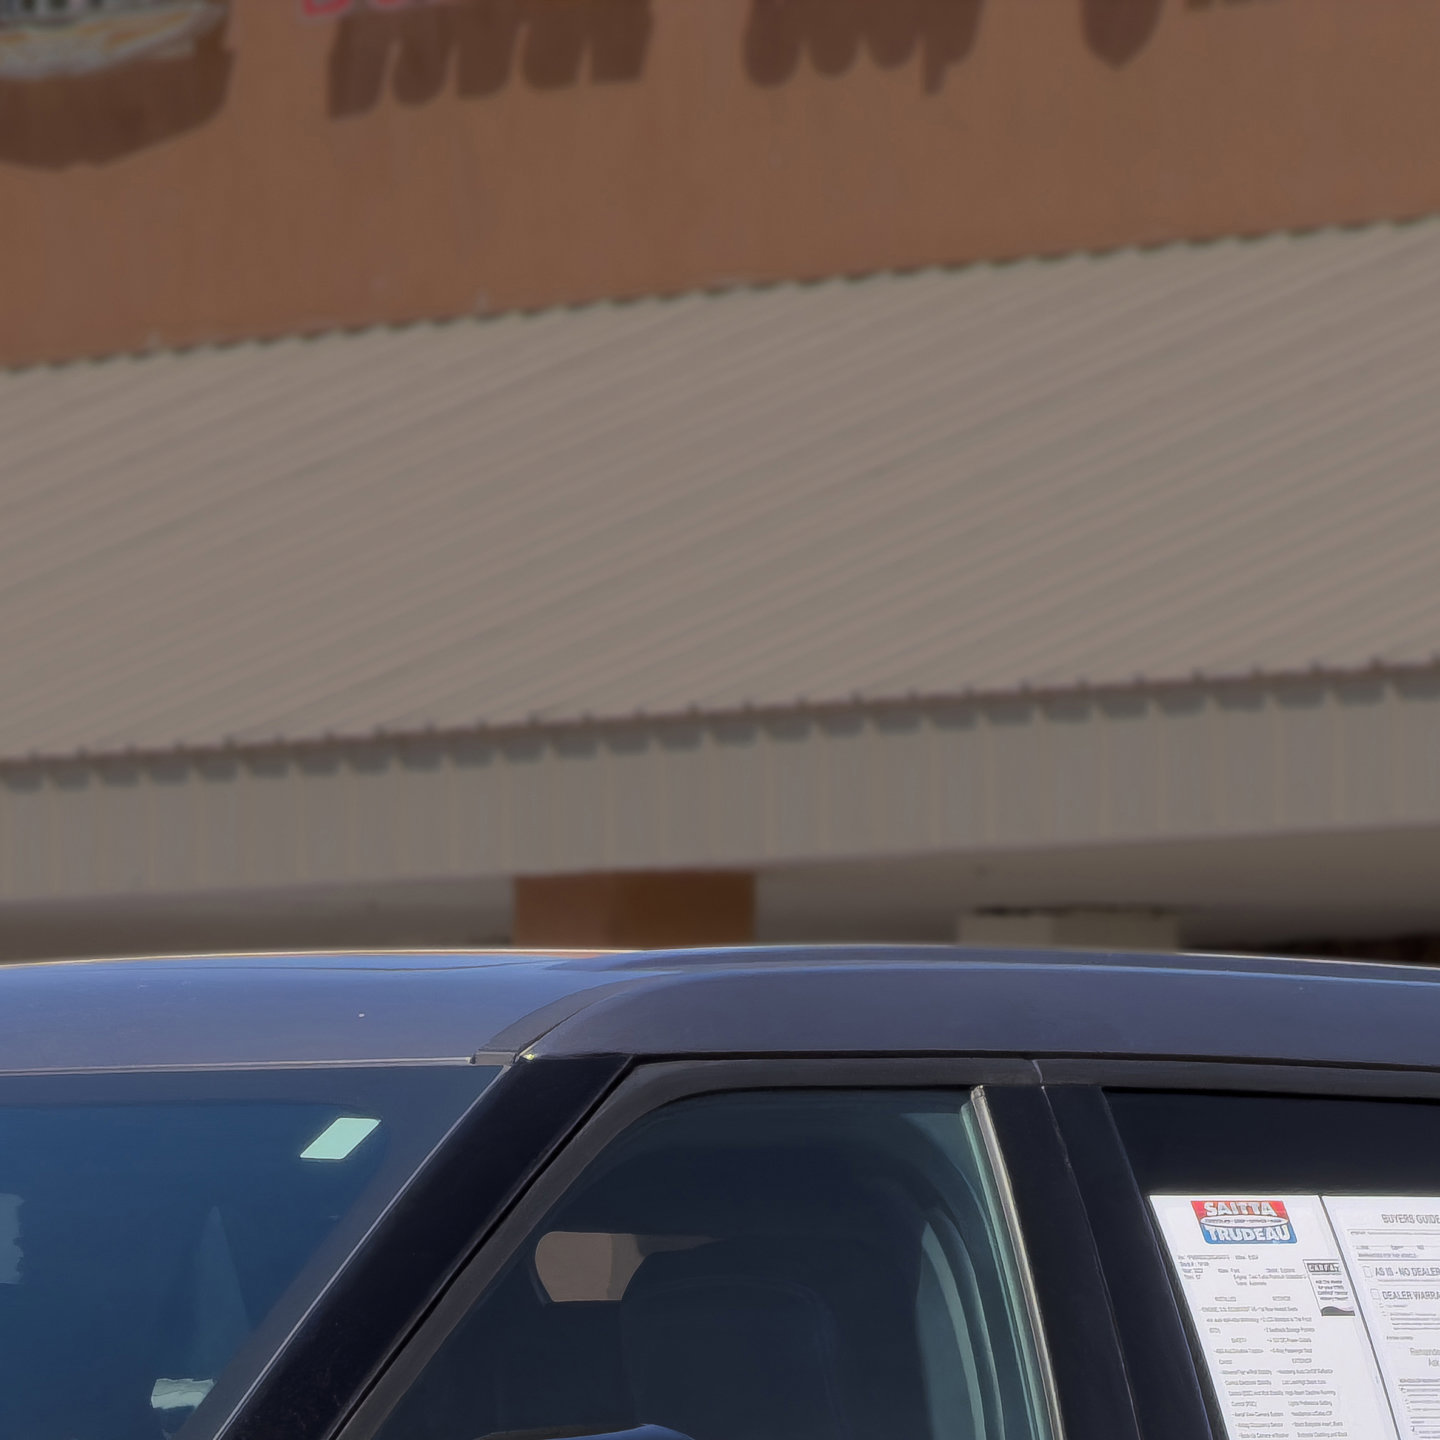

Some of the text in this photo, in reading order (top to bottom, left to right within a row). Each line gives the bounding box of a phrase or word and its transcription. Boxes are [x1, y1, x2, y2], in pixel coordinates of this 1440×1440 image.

[1204, 1201, 1278, 1217] SAITTA
[1381, 1213, 1415, 1224] BUYERS
[1206, 1226, 1292, 1241] TRUDEAU
[1382, 1291, 1412, 1300] DEALER
